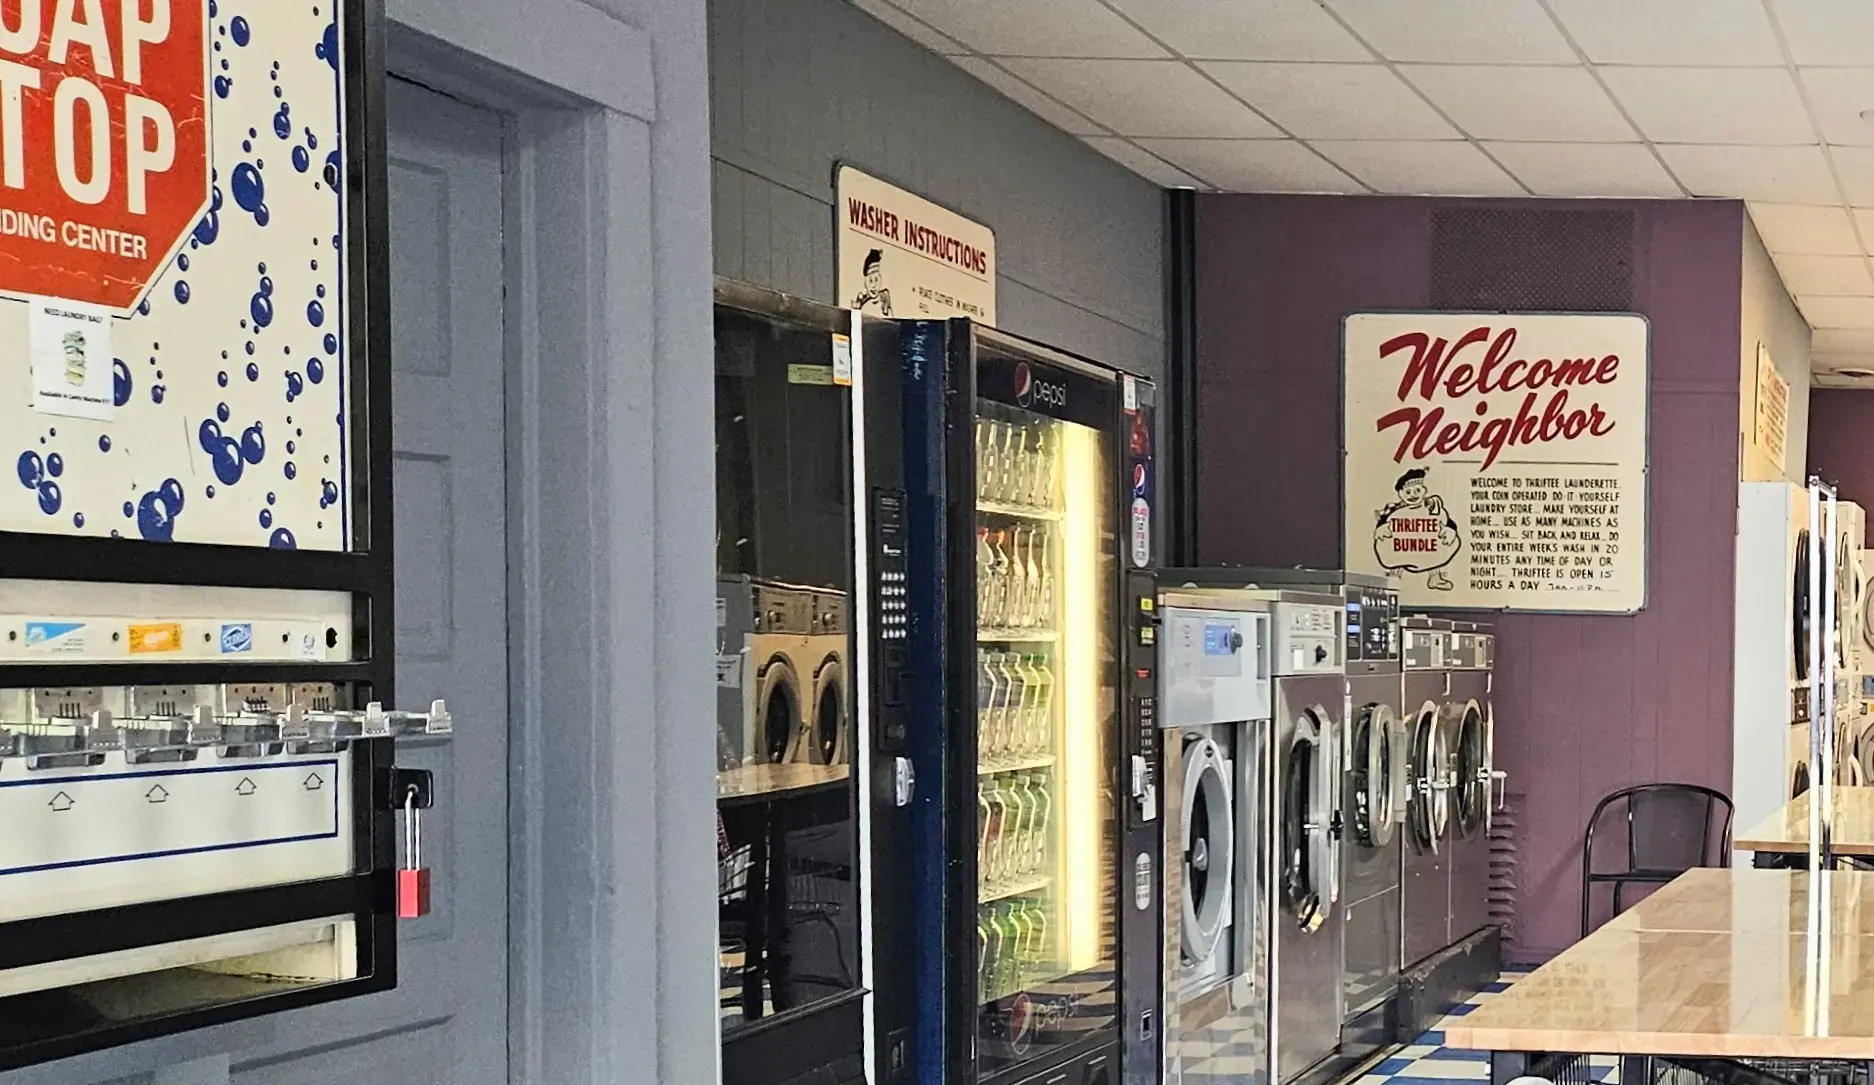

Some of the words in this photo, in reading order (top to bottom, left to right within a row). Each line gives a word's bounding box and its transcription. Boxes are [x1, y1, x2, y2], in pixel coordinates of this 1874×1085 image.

[0, 59, 175, 215] TOP
[0, 208, 55, 242] DING
[62, 221, 147, 260] CENTER
[848, 197, 899, 241] WASHER
[904, 219, 986, 275] INSTRUCTIONS
[1379, 327, 1620, 402] Welcome
[1033, 380, 1066, 408] pepsi
[1376, 389, 1616, 472] Neighbor
[1470, 478, 1508, 488] WELCOME
[1512, 478, 1522, 488] TO
[1526, 478, 1559, 488] THRIFTEE
[1470, 491, 1489, 501] YOUR
[1492, 491, 1509, 501] COIN
[1512, 491, 1548, 501] OPERATED
[1580, 492, 1619, 501] YOURSELF
[1470, 504, 1506, 514] LAUNDRY
[1543, 504, 1564, 514] MAKE
[1569, 504, 1606, 514] YOURSELF
[1609, 504, 1619, 514] AT
[1391, 518, 1438, 532] THRIFTEE
[1504, 516, 1517, 526] USE
[1521, 516, 1531, 527] AS
[1535, 517, 1557, 527] MANY
[1561, 517, 1601, 527] MACHINES
[1606, 517, 1618, 527] AS
[1470, 529, 1485, 540] YOU
[1522, 530, 1534, 540] SIT
[1538, 530, 1556, 540] BACK
[1560, 530, 1576, 540] AND
[1609, 530, 1619, 541] DO
[1394, 538, 1437, 552] BUNDLE
[1470, 543, 1492, 552] YOUR
[1497, 543, 1524, 552] ENTIRE
[1563, 543, 1585, 553] WASH
[1591, 543, 1599, 553] IN
[1606, 543, 1619, 553] 20
[1470, 555, 1510, 565] MINUTES
[1515, 555, 1533, 565] ANY
[1537, 555, 1555, 565] TIME
[1559, 555, 1570, 565] OF
[1575, 556, 1593, 565] DAY
[1600, 556, 1613, 566] OR
[1511, 567, 1551, 578] THRIFTEE
[1556, 568, 1564, 578] IS
[1570, 568, 1594, 578] OPEN
[1600, 568, 1614, 578] 15
[1470, 580, 1503, 590] HOURS
[1508, 580, 1515, 590] A
[1521, 580, 1540, 590] DAY
